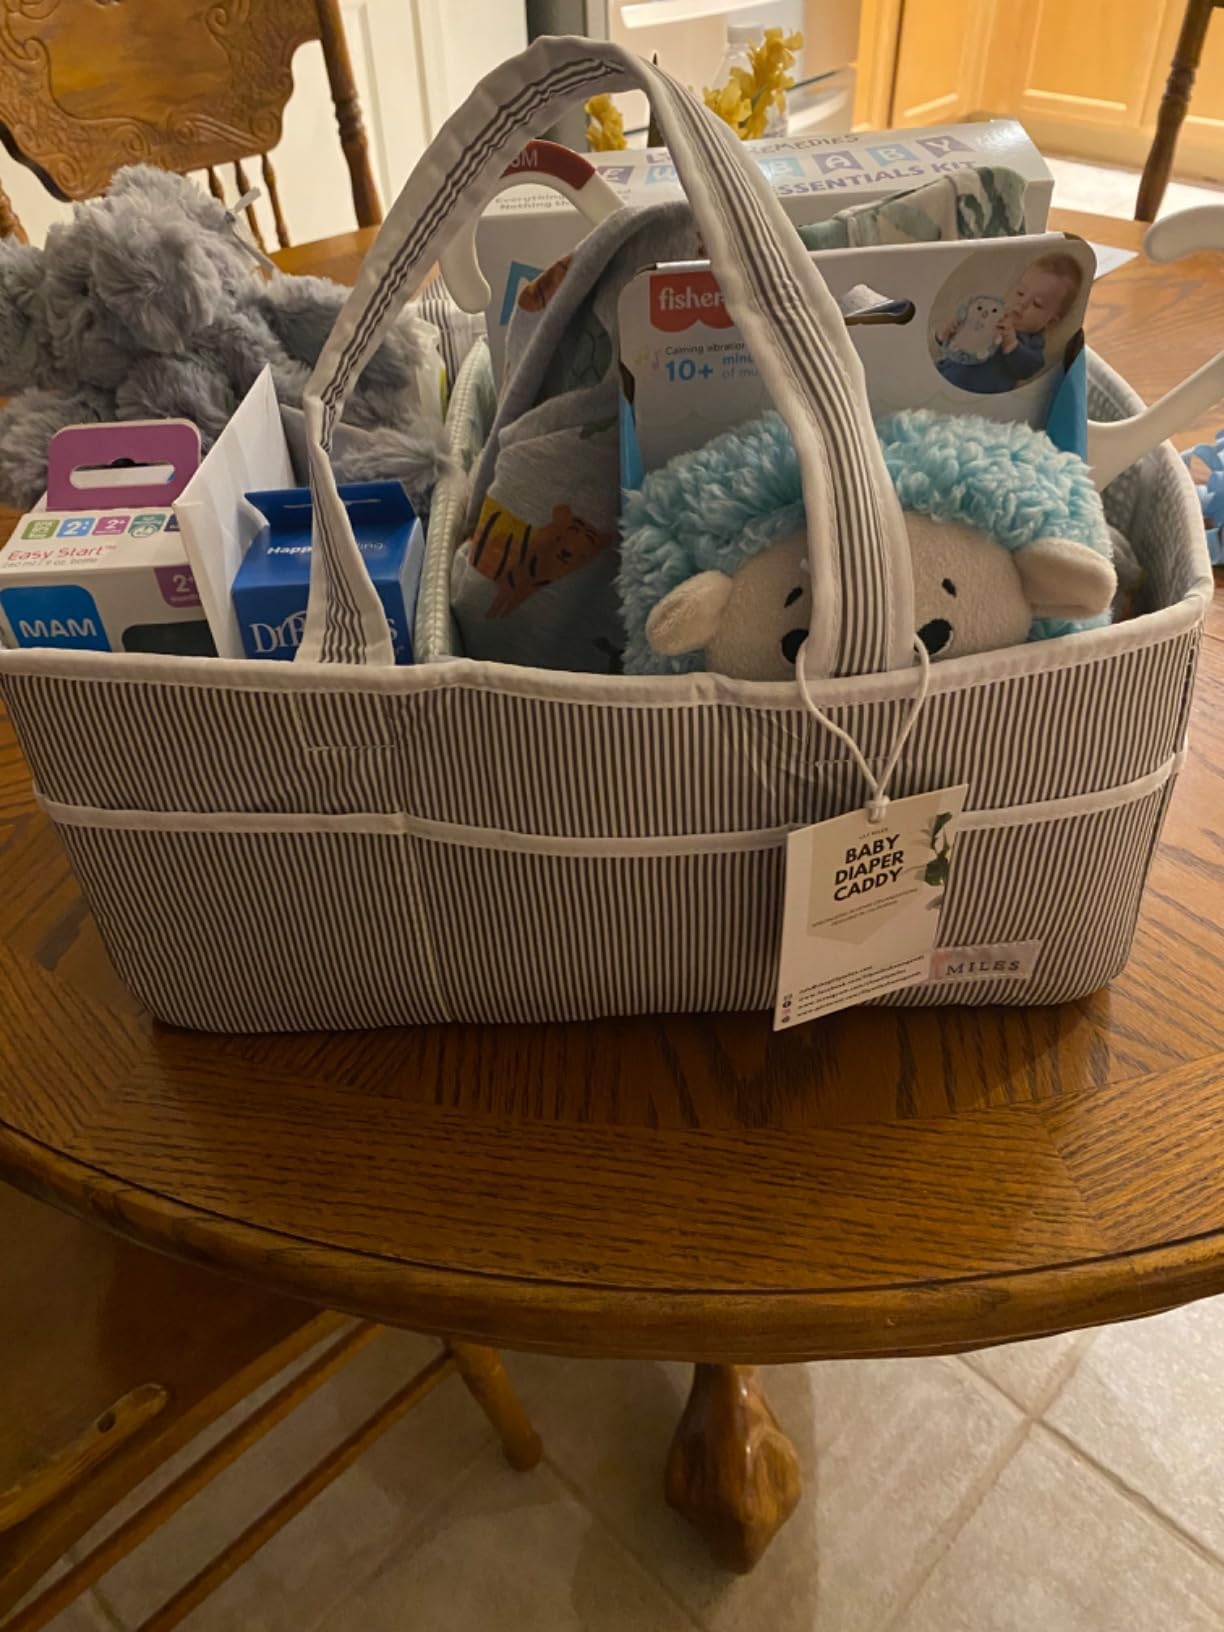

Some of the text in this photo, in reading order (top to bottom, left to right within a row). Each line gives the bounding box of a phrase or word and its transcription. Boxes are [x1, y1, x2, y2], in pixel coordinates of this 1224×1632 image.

[774, 160, 977, 195] SSENTIALS KIT
[665, 344, 704, 356] Calming
[665, 358, 713, 383] 10+
[7, 550, 54, 562] Easy
[19, 617, 98, 639] MAM
[845, 833, 900, 864] BABY
[835, 850, 904, 885] DIAPER
[834, 866, 903, 901] CADDY
[946, 960, 1020, 976] MILES
